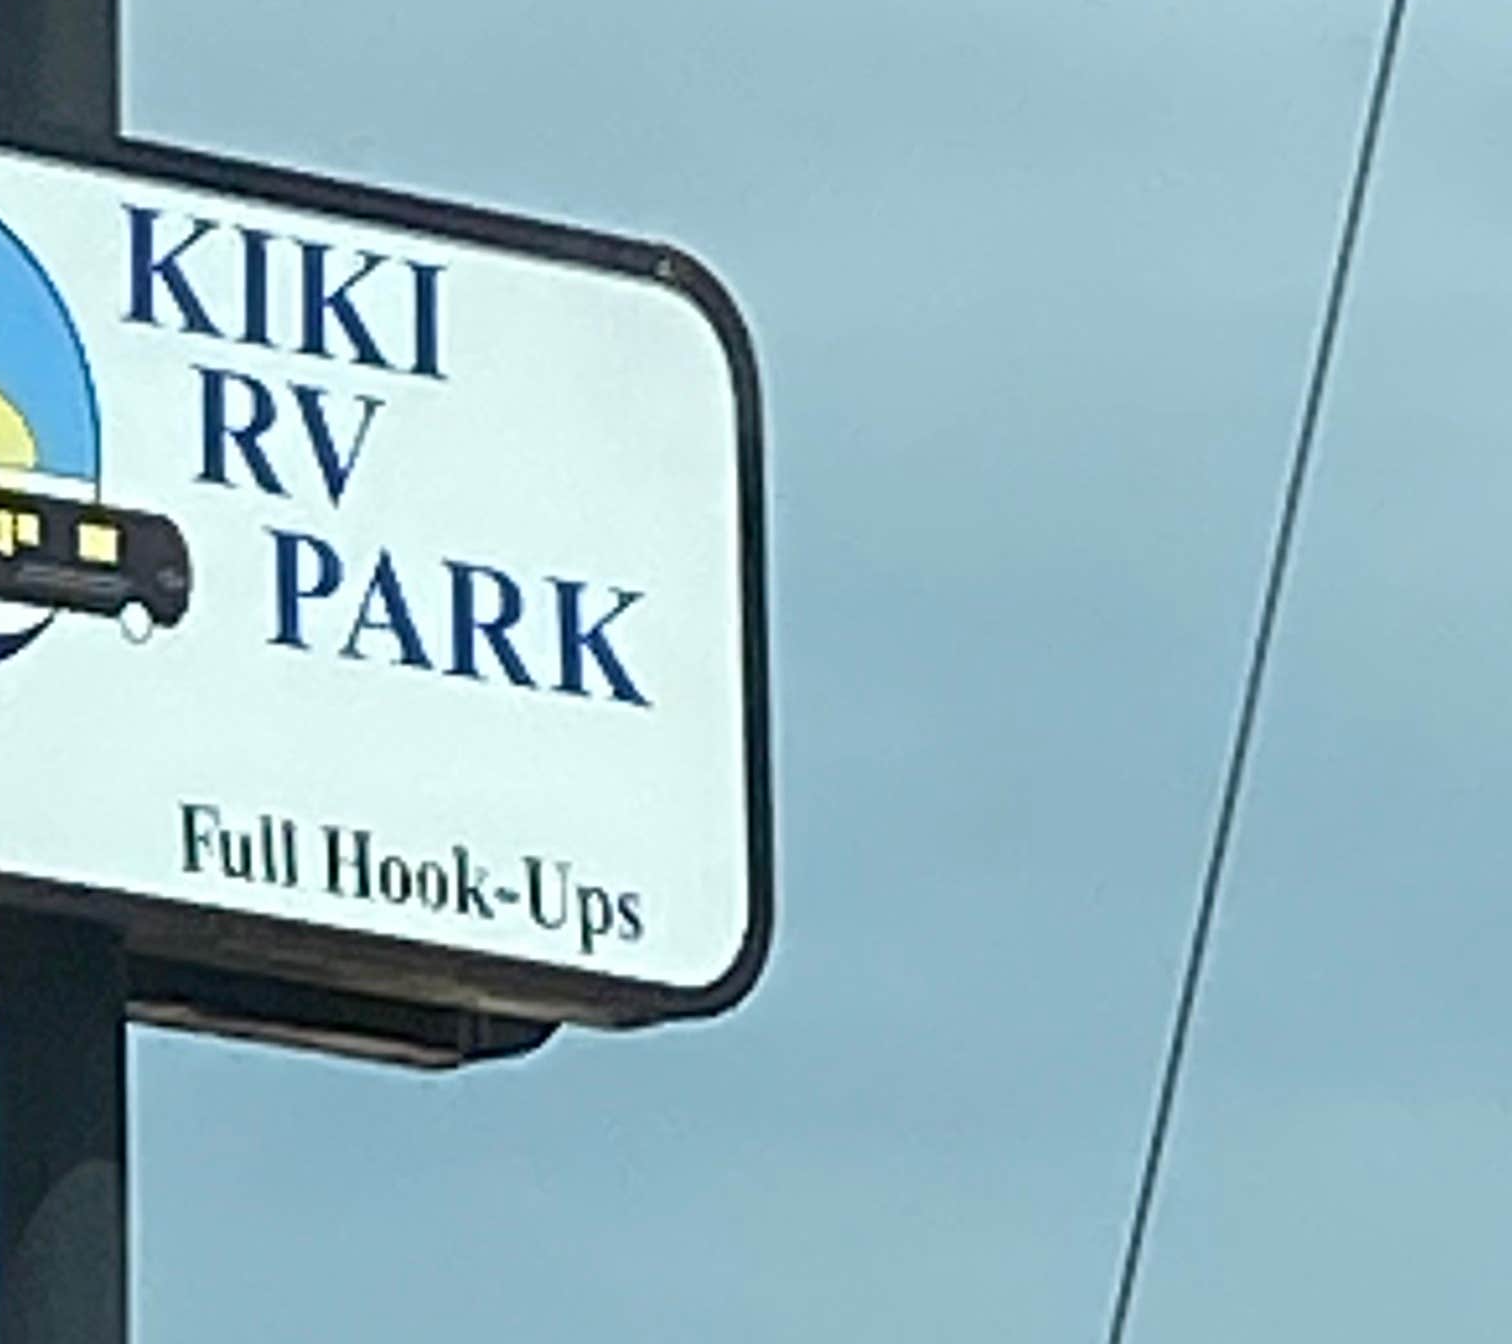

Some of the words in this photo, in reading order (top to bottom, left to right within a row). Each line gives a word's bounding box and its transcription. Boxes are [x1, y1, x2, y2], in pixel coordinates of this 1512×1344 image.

[120, 202, 449, 381] KIKI
[189, 362, 386, 509] RV
[263, 525, 653, 709] PARK
[179, 802, 299, 889] Full
[322, 825, 645, 954] Hook-Ups
